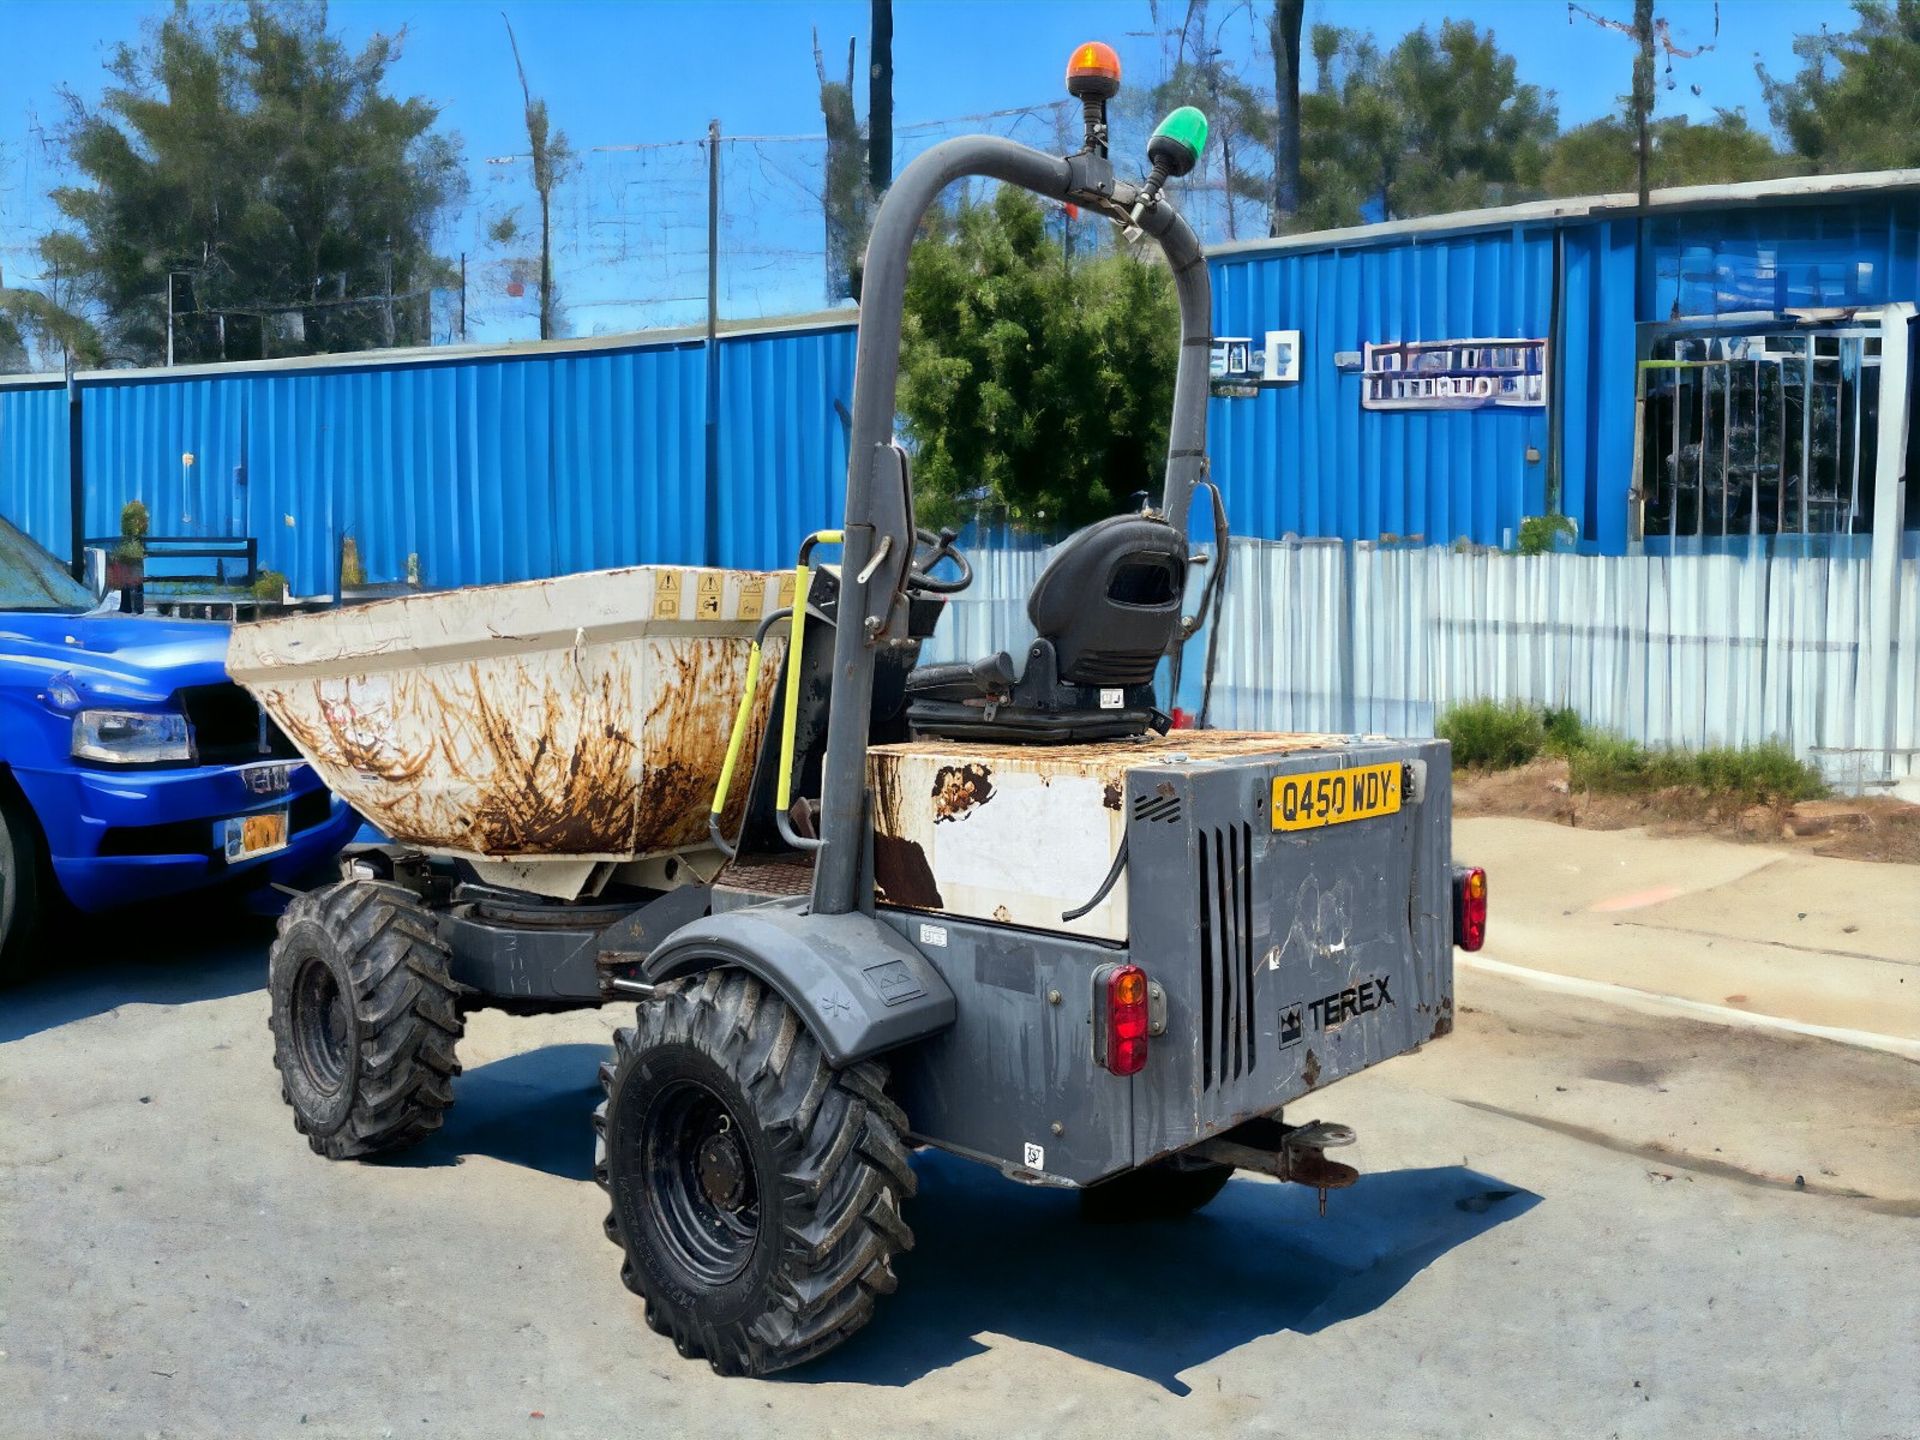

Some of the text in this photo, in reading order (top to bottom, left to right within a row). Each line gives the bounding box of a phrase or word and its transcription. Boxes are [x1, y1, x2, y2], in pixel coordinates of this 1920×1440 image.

[1283, 769, 1392, 822] Q450 WDY
[1308, 975, 1394, 1031] TEREX
